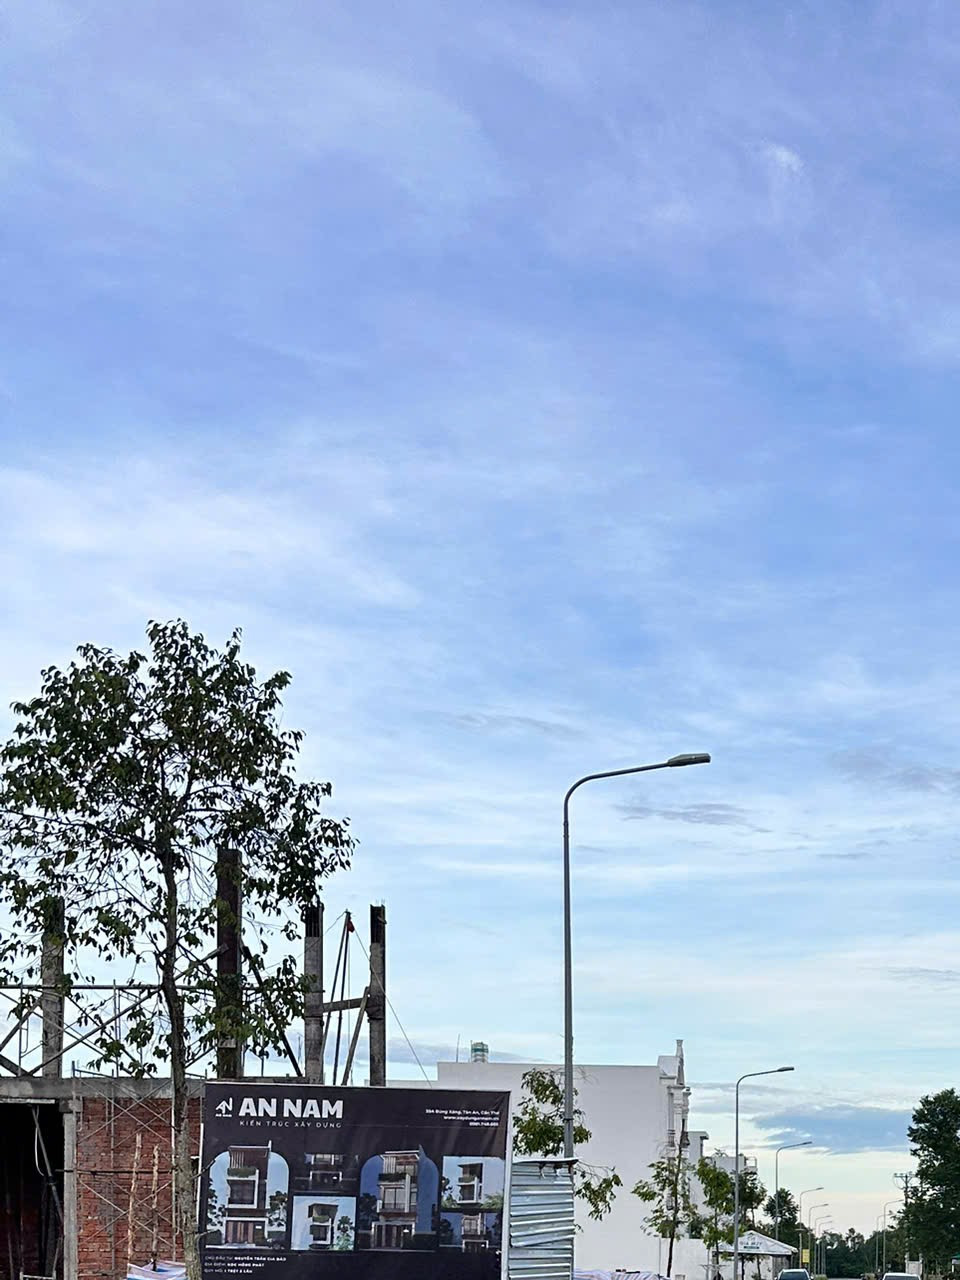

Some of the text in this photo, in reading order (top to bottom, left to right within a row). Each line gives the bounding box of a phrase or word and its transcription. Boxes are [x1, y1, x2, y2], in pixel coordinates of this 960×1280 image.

[238, 1097, 344, 1119] AN NAM
[239, 1119, 262, 1127] KIẾN
[266, 1120, 289, 1128] TRÚC
